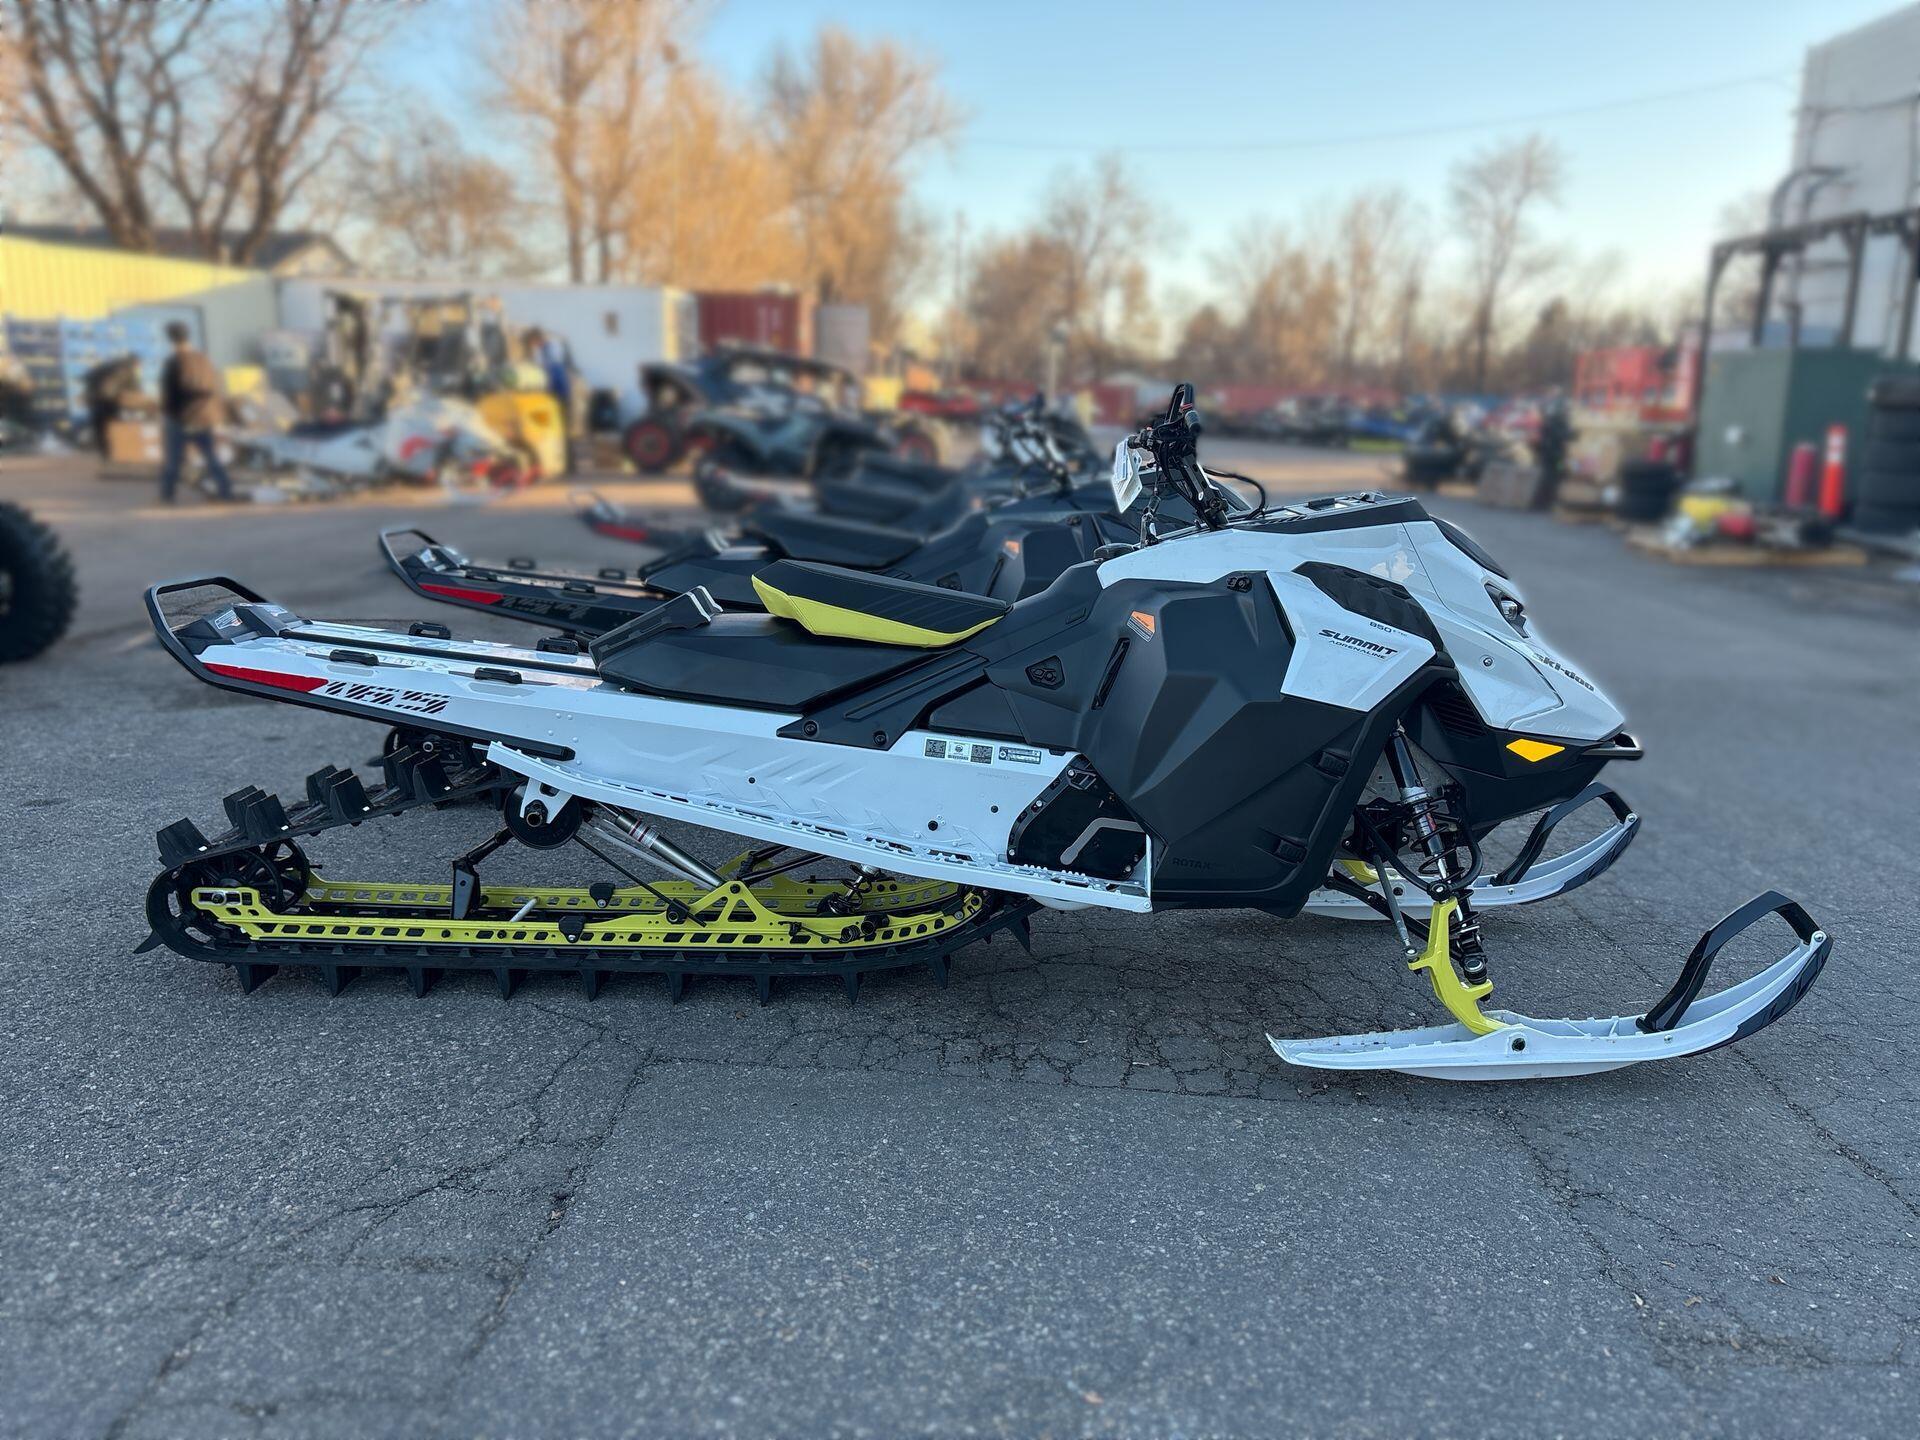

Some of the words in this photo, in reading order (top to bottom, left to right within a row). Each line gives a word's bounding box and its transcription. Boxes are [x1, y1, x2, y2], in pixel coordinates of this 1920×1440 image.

[1369, 621, 1392, 633] 850
[1318, 629, 1398, 655] SUMMIT
[1328, 640, 1387, 659] ADRENALINE
[1172, 857, 1211, 870] ROTAX
